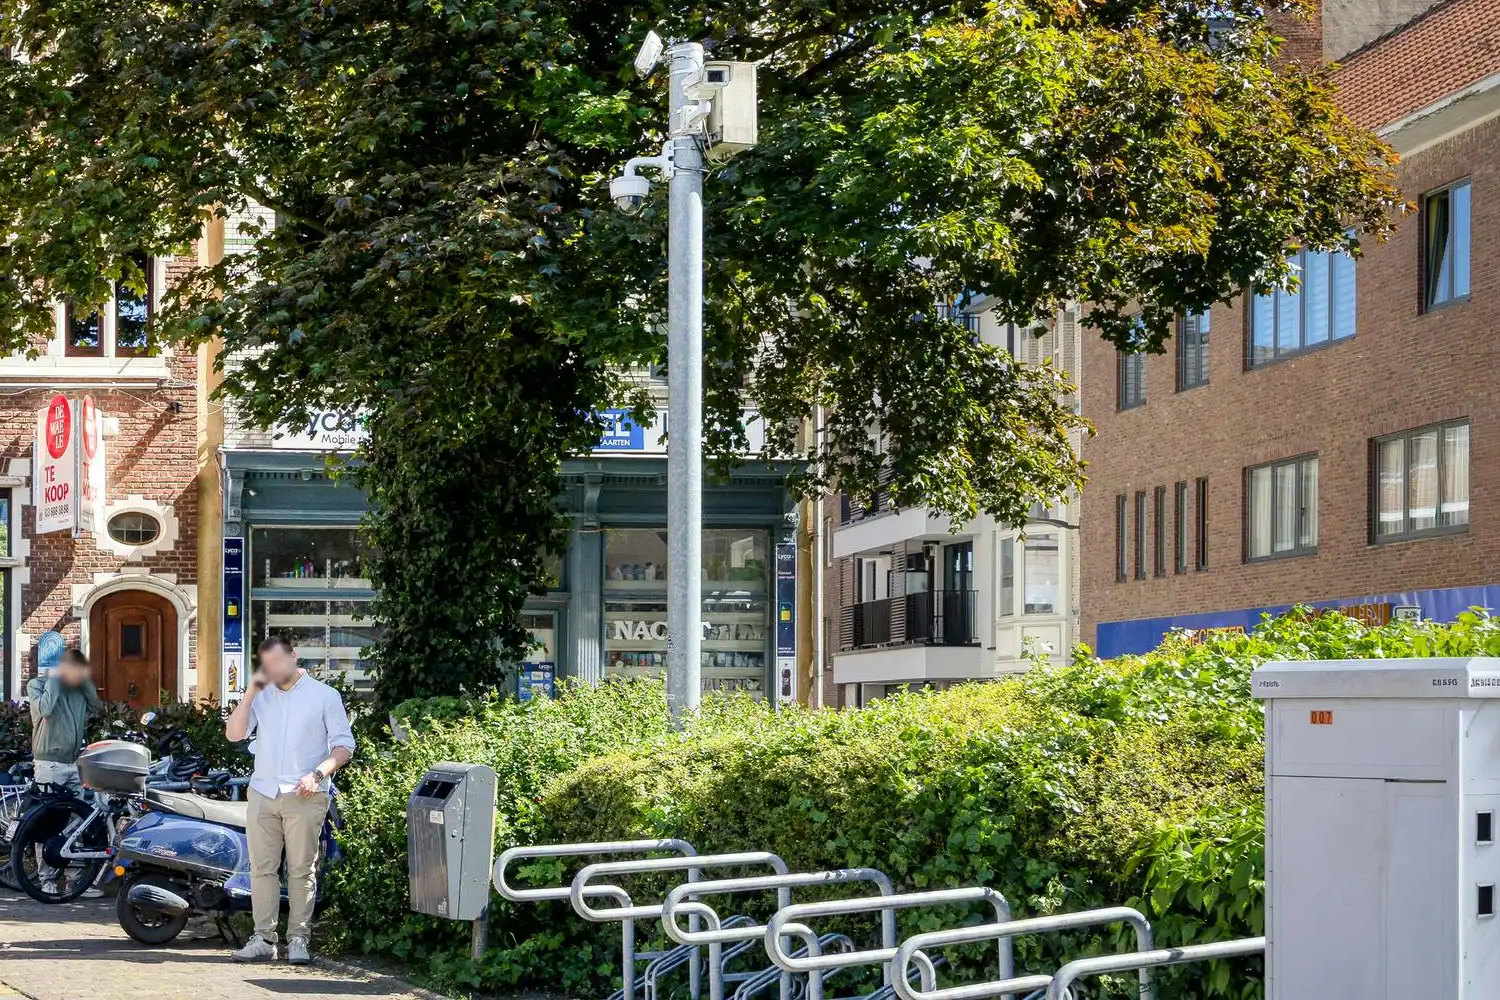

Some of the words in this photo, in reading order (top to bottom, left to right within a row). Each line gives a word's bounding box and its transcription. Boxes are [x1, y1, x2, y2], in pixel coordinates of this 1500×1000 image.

[55, 404, 65, 419] DE
[55, 435, 64, 449] LE
[321, 434, 356, 444] Mobile
[600, 438, 631, 447] AARTEN
[44, 465, 55, 483] TE
[44, 483, 69, 503] KOOP
[613, 620, 712, 641] NACT
[1311, 710, 1333, 724] 007
